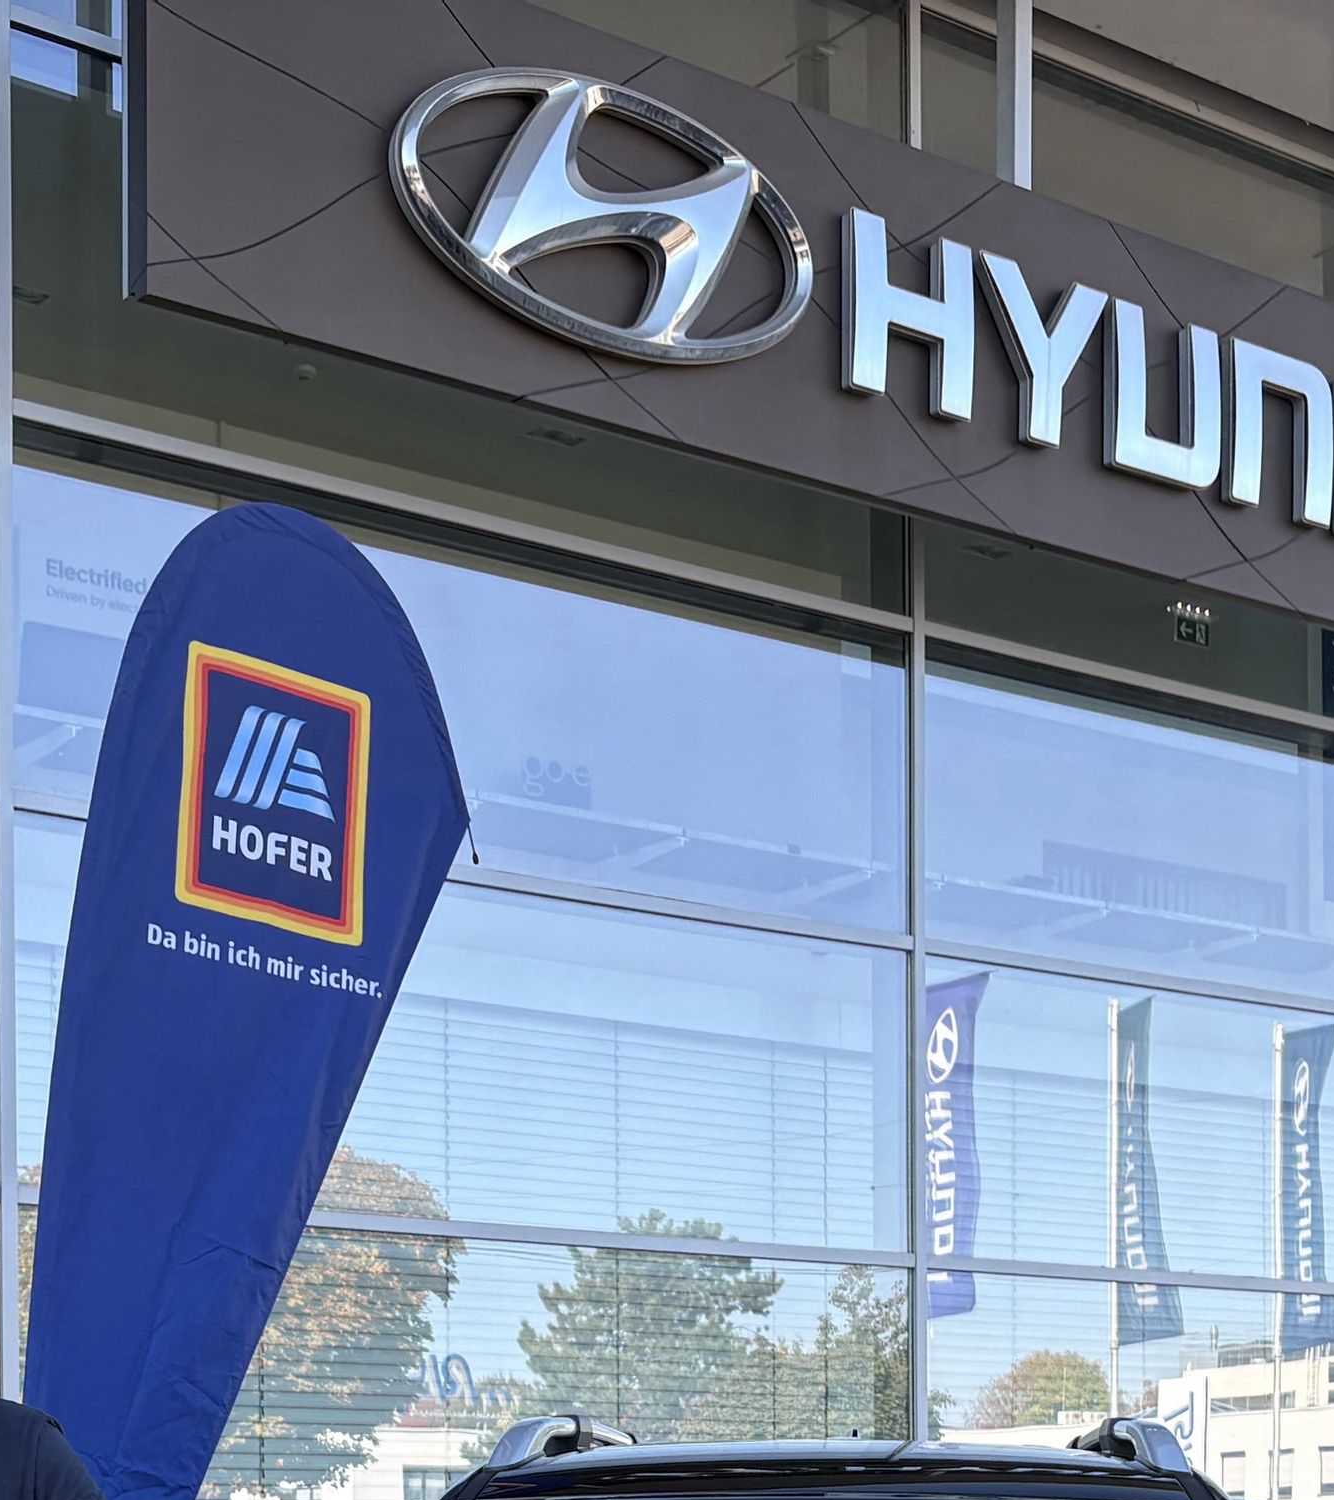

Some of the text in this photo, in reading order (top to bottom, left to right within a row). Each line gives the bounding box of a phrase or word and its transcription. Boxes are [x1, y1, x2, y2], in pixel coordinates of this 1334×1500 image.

[46, 558, 147, 595] Electrified
[212, 815, 333, 882] HOFER
[147, 923, 382, 998] Da bin ich mir sicher.
[925, 1091, 956, 1281] HYUNDI
